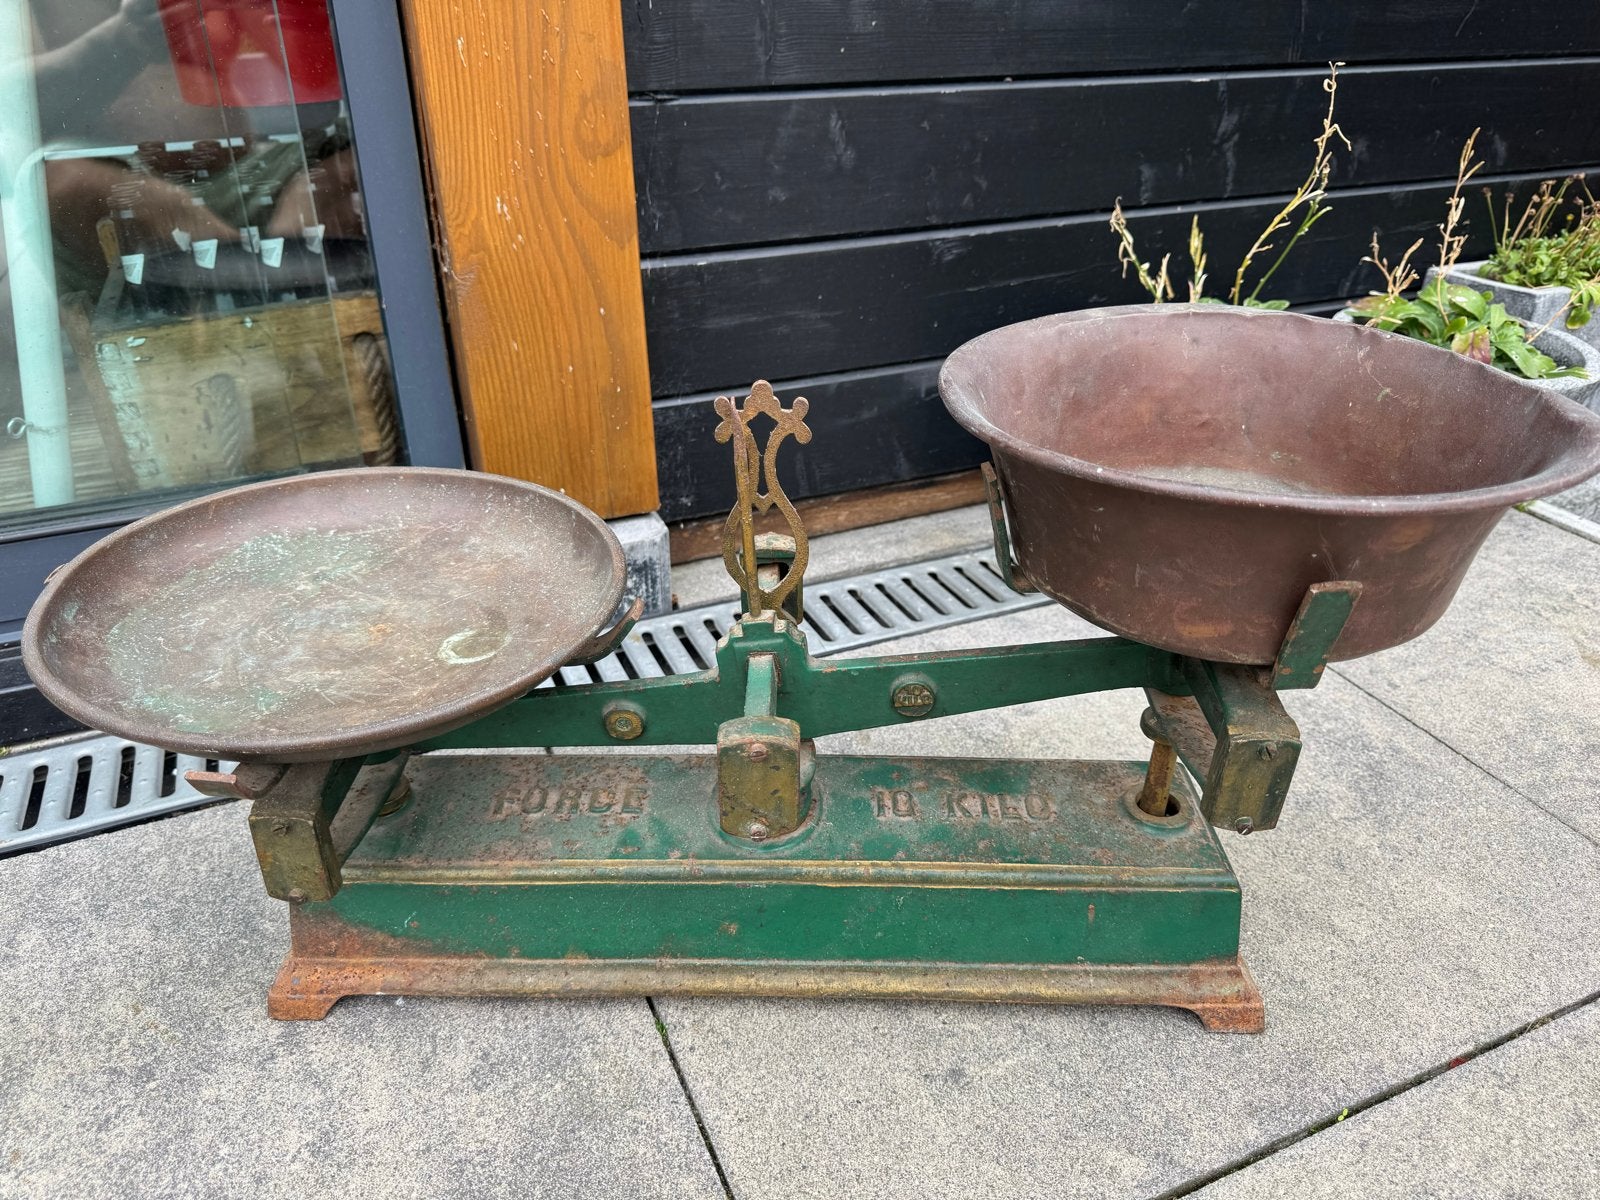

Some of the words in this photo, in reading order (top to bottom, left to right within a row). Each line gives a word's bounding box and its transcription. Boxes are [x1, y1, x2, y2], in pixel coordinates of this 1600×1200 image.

[895, 693, 932, 707] KILO
[492, 786, 648, 816] FORCE
[872, 789, 917, 819] 10
[939, 791, 1056, 821] KILO
